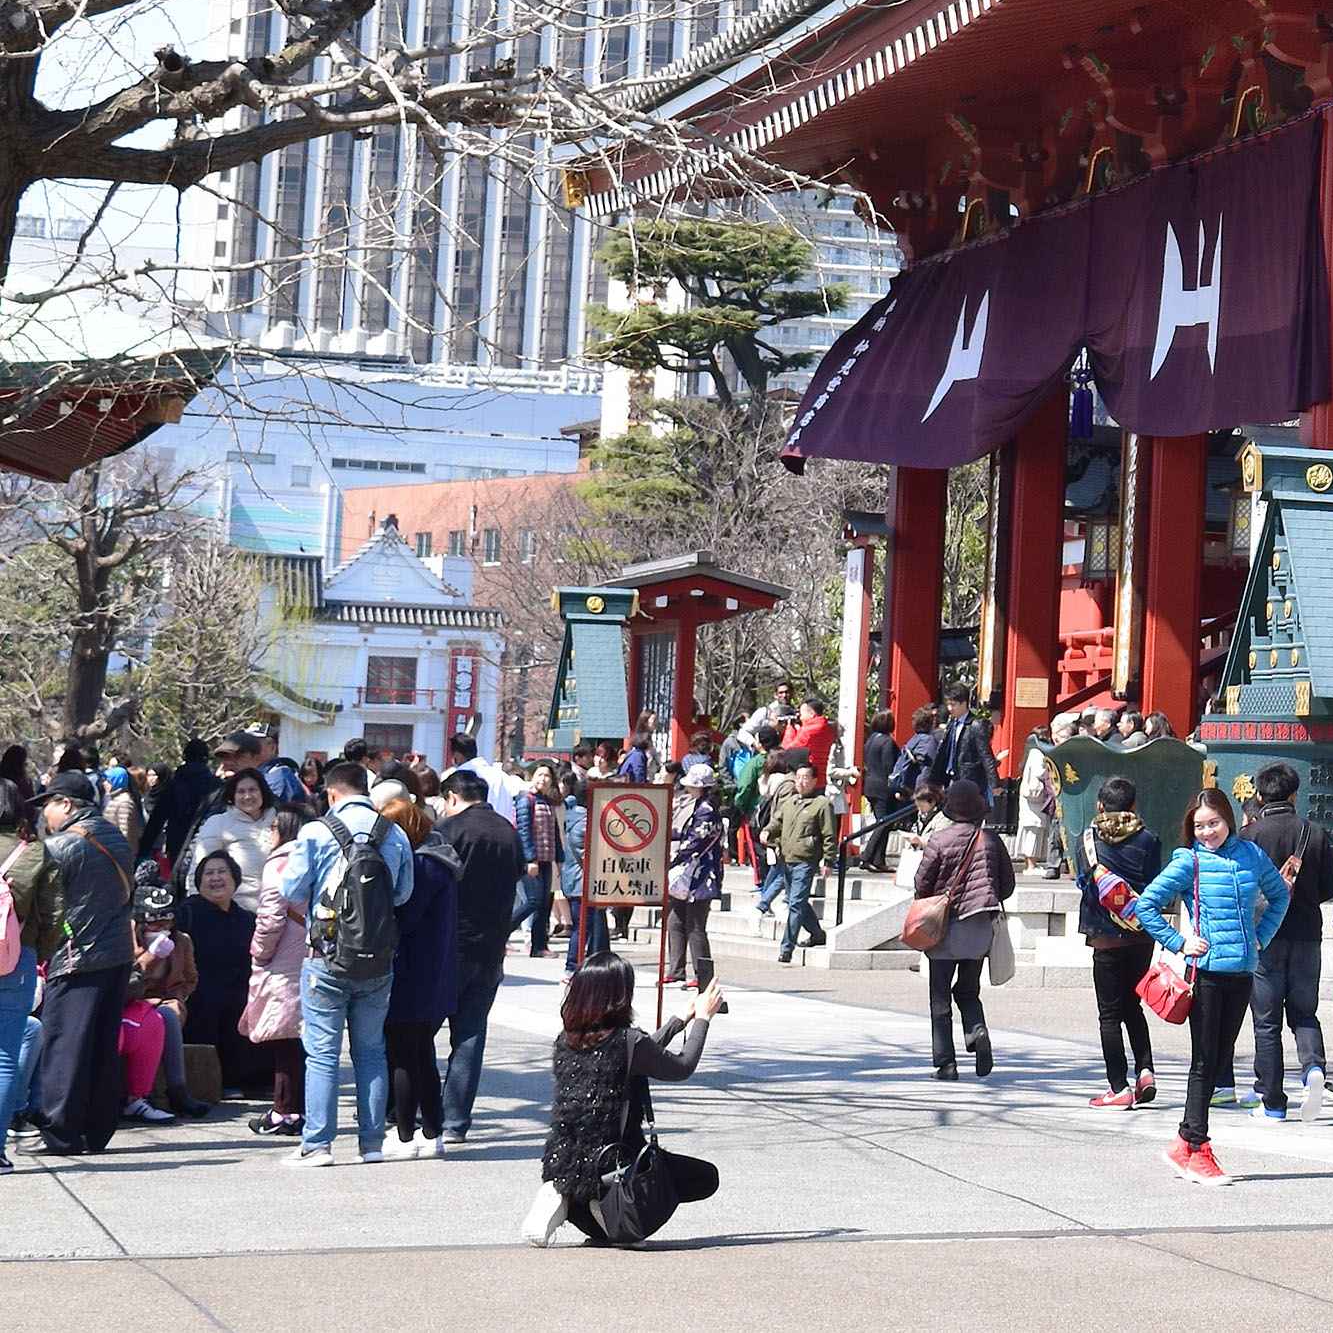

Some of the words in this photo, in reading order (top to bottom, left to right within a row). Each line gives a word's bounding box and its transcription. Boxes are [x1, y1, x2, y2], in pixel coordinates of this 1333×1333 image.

[602, 857, 652, 874] 自転車
[592, 880, 659, 897] 進入禁止
